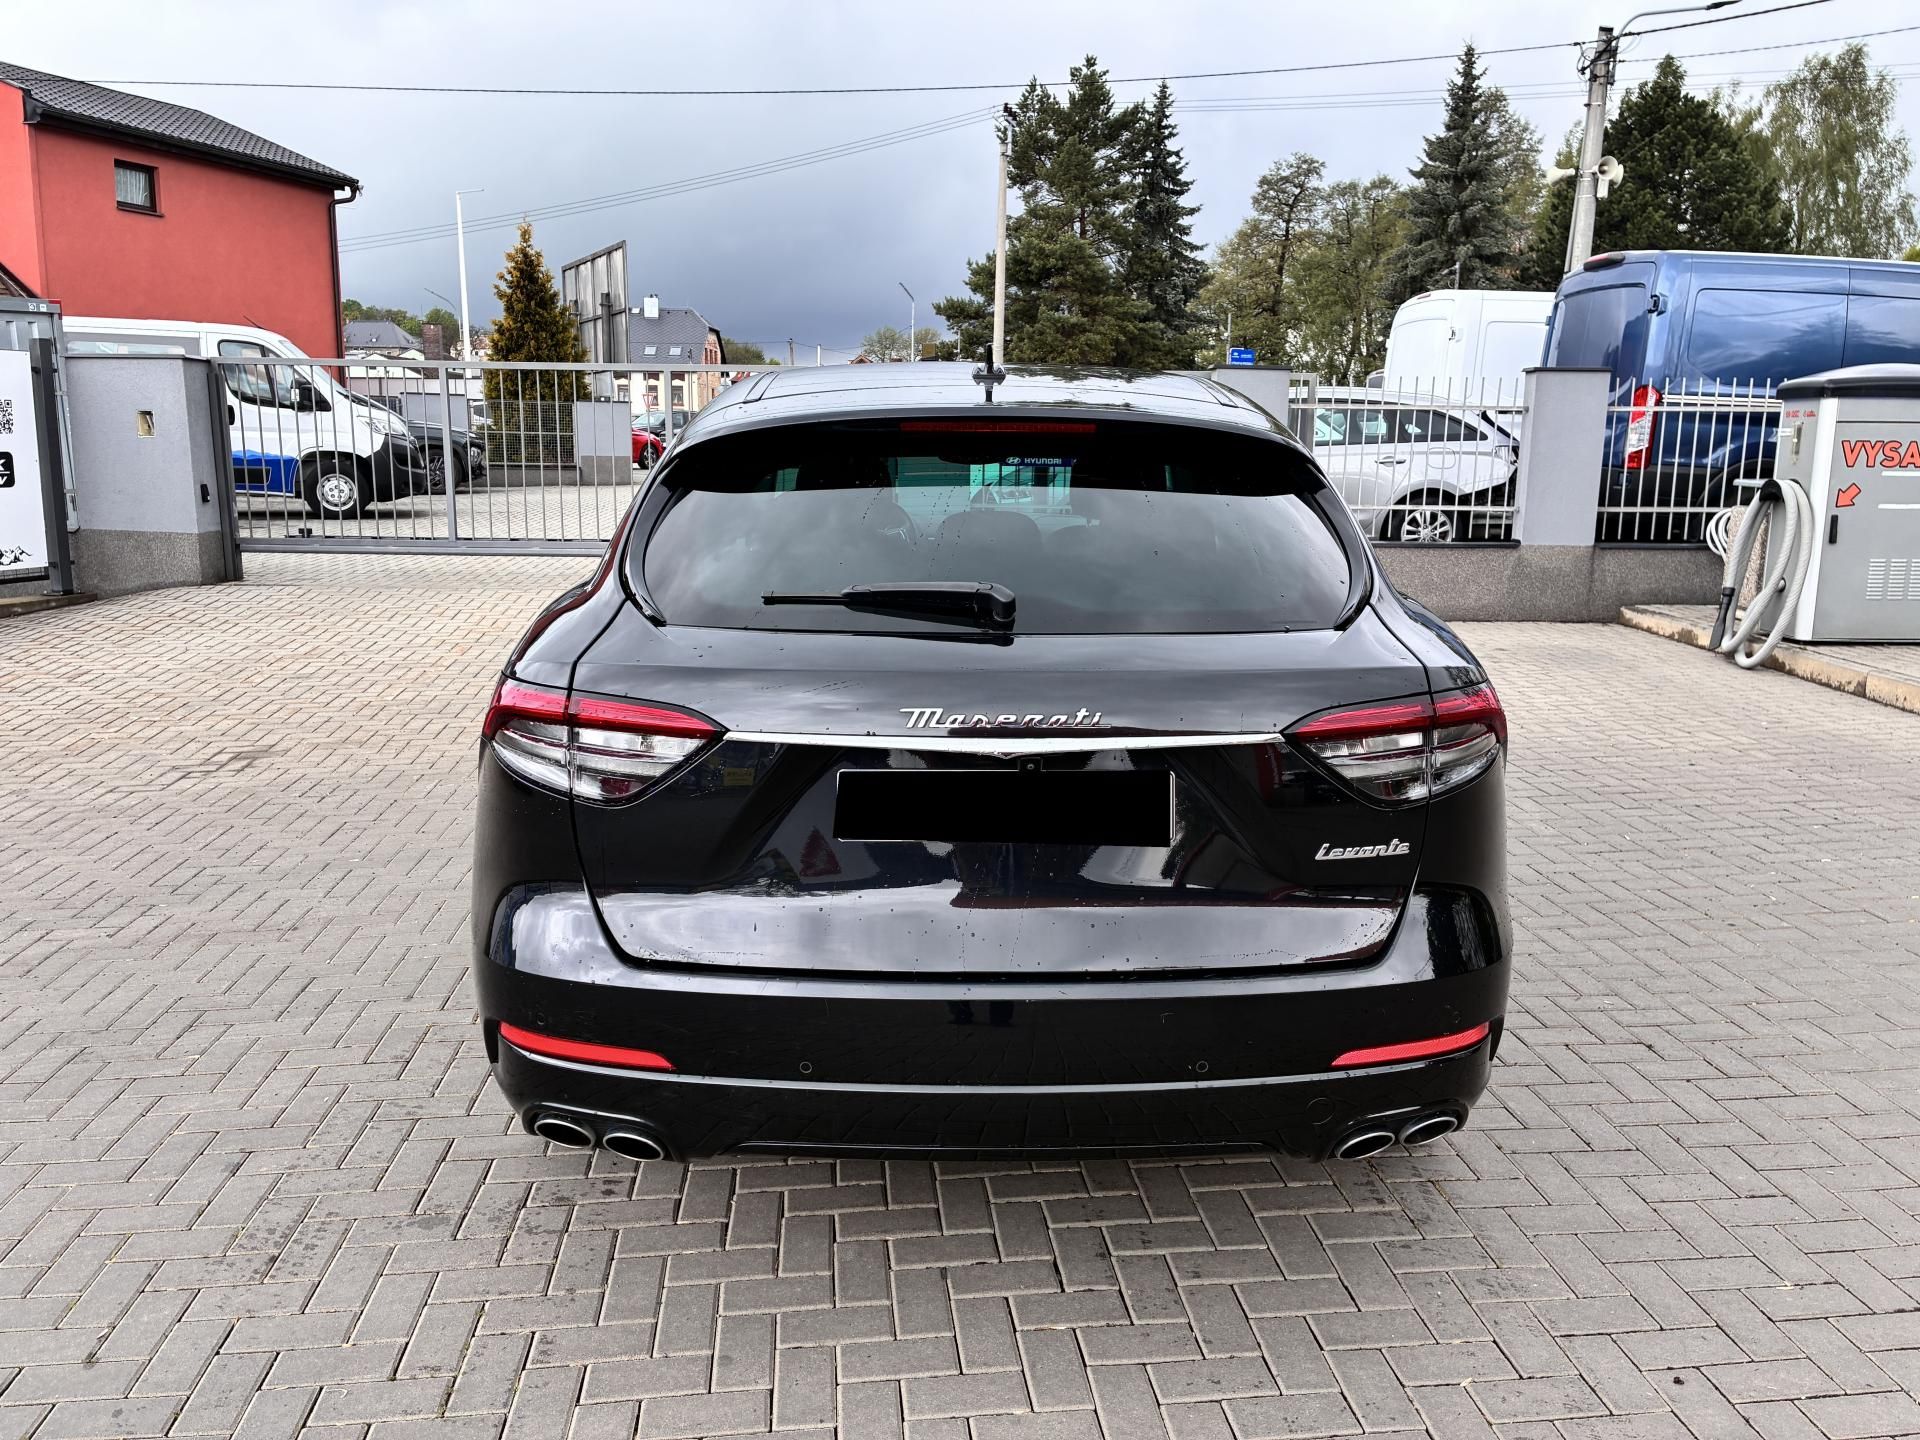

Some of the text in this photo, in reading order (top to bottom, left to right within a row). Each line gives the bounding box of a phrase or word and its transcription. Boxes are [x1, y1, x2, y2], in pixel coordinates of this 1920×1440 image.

[1024, 457, 1062, 465] HYUNDAI
[899, 707, 1112, 729] Maserati
[1314, 838, 1410, 860] Levante
